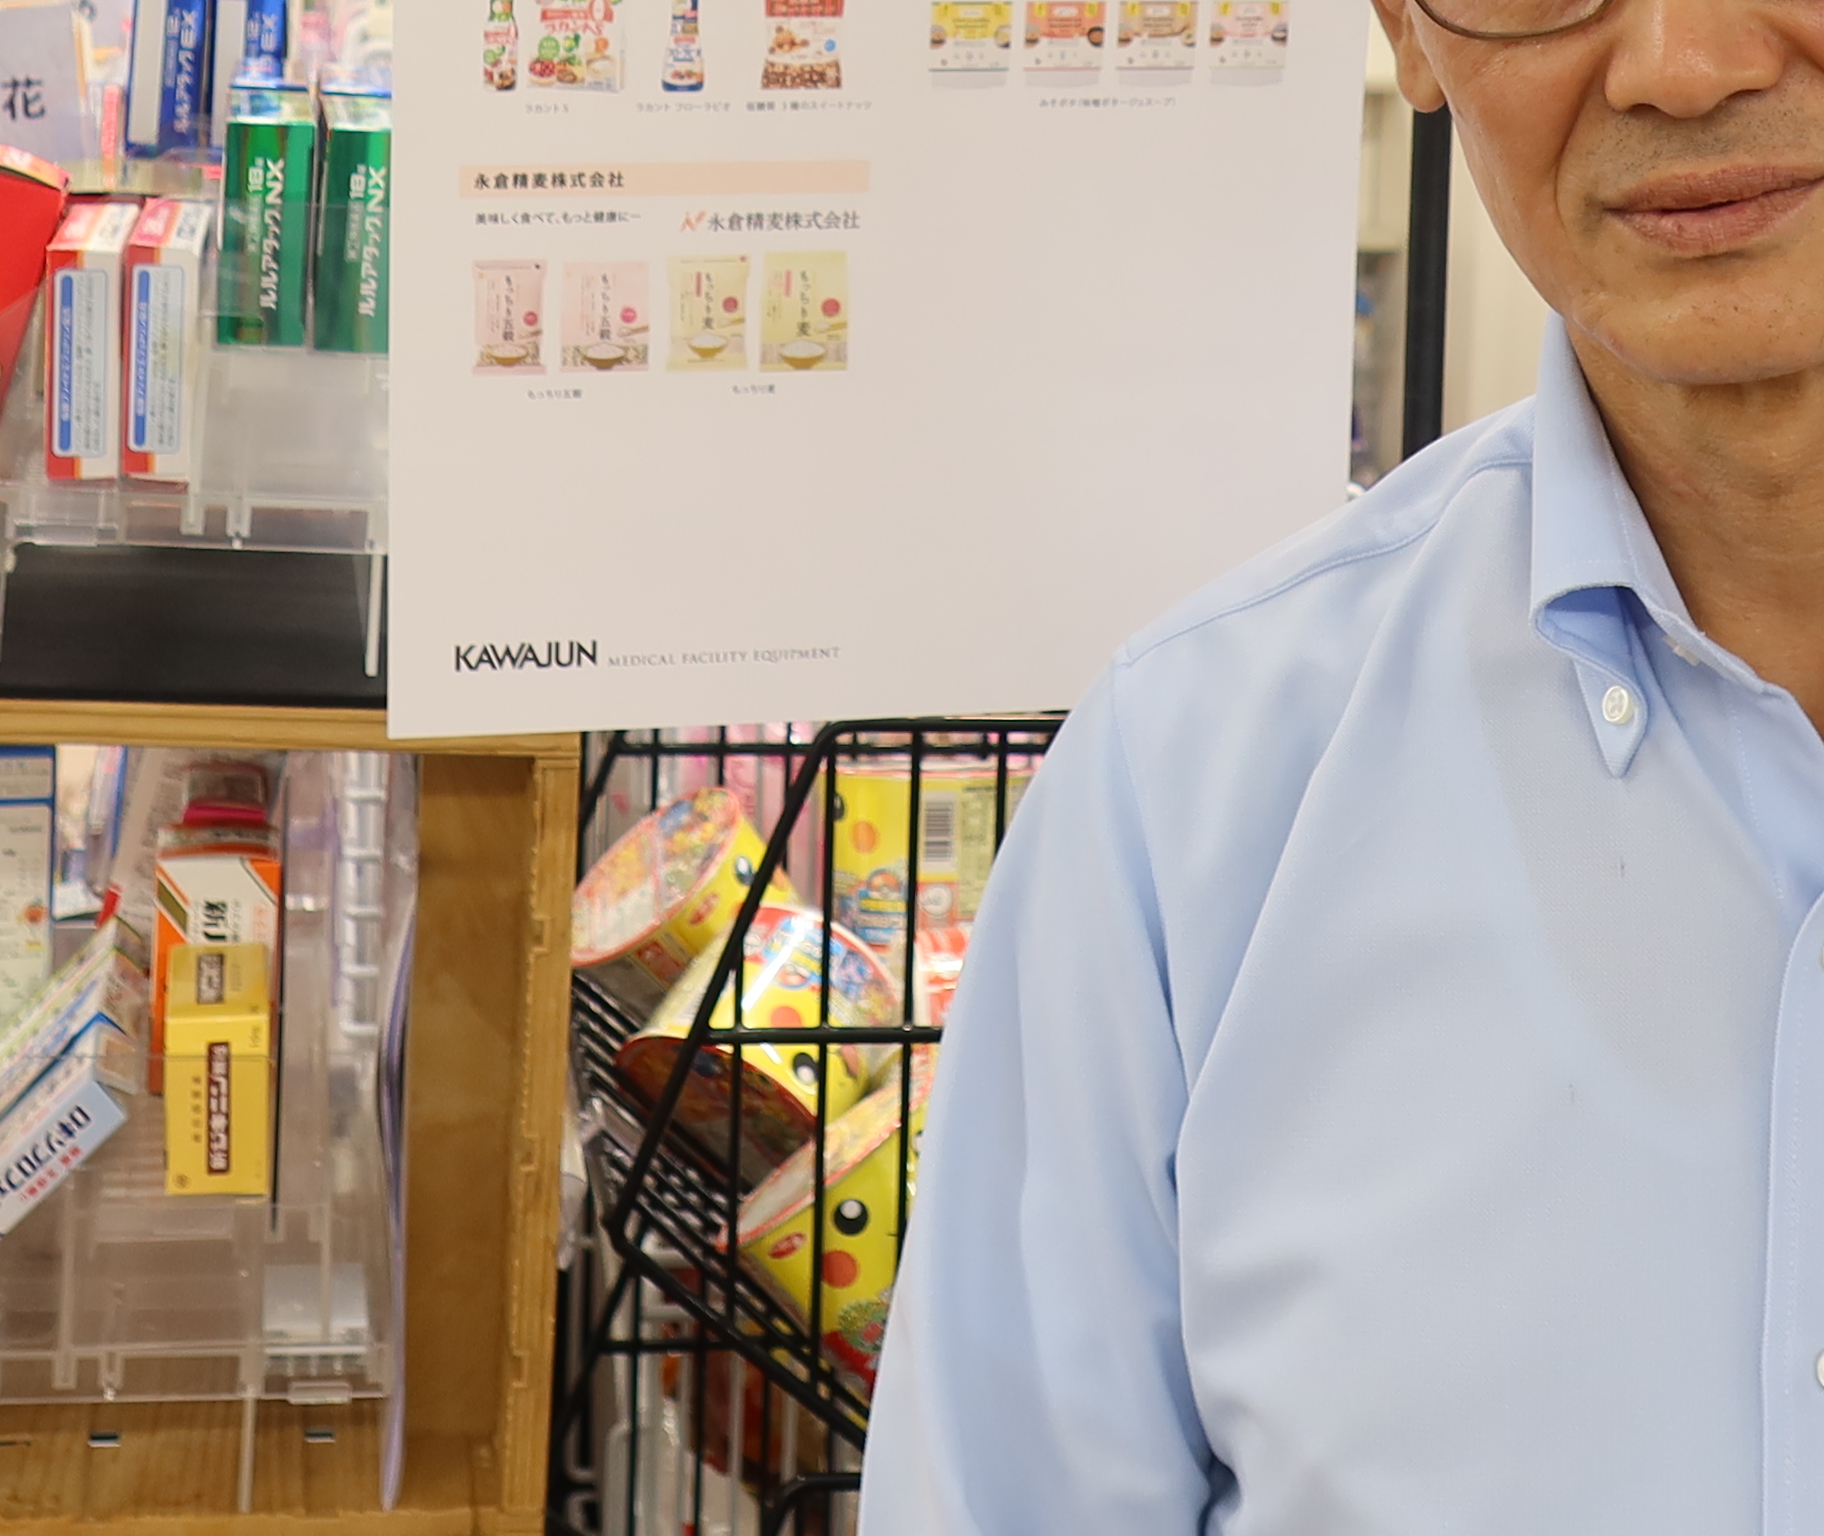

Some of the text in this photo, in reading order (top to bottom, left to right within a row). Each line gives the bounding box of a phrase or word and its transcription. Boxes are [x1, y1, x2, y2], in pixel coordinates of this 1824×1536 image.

[1, 78, 47, 121] 花
[474, 171, 625, 190] 永倉精麦株式会社
[707, 210, 861, 232] 永倉精麦株式会社
[454, 640, 840, 672] KAWAJUN MEDICAL FACILITY EQUIPMENT
